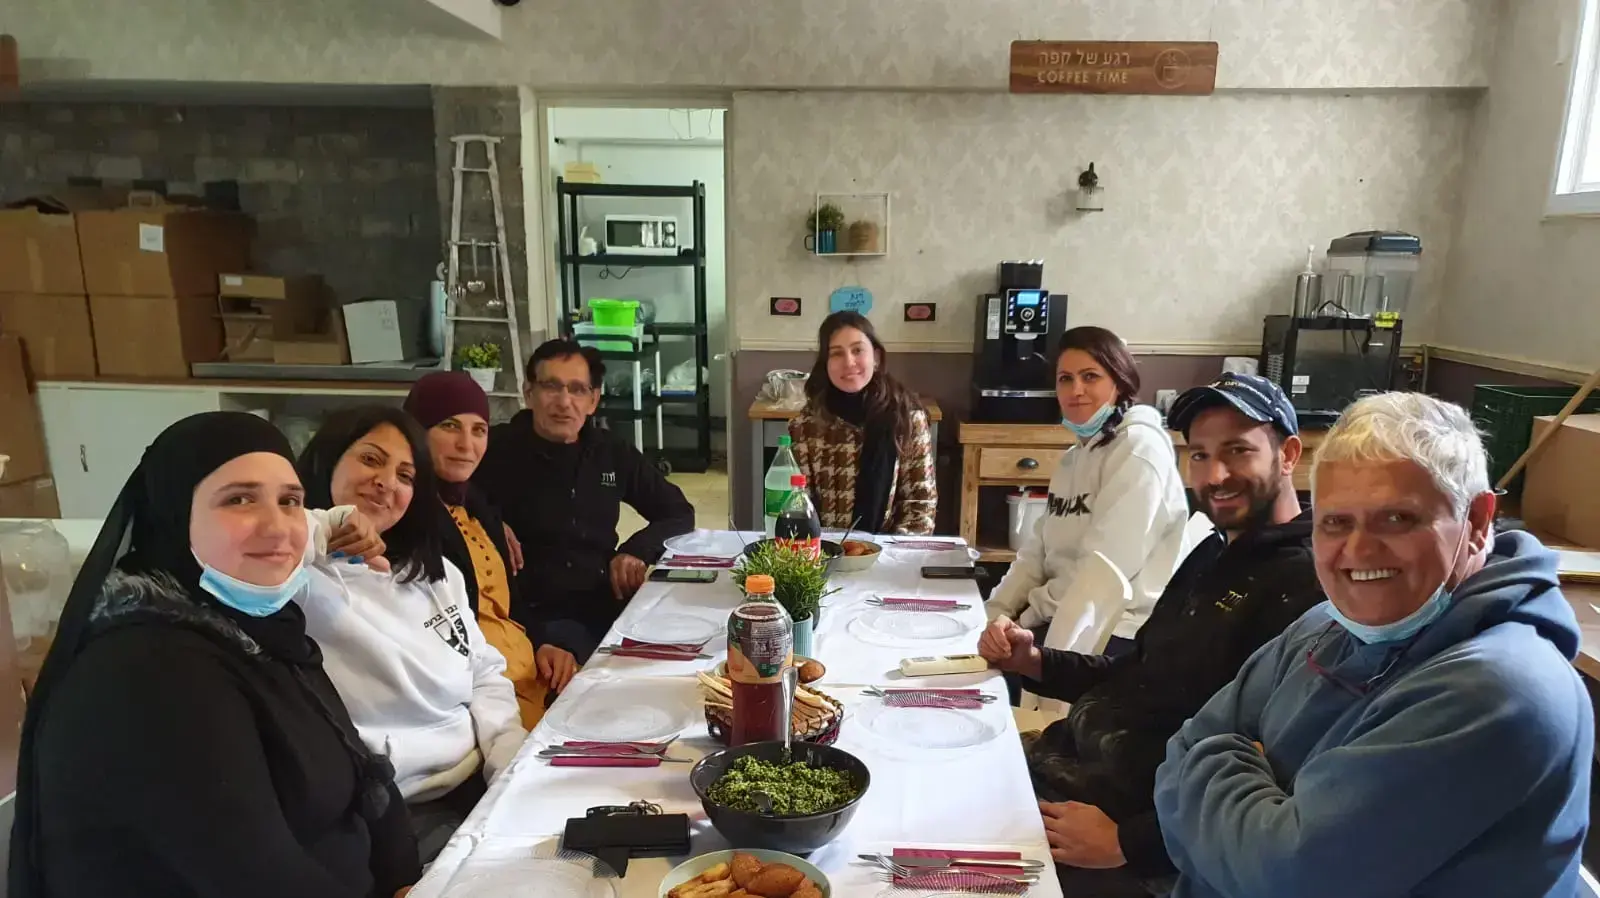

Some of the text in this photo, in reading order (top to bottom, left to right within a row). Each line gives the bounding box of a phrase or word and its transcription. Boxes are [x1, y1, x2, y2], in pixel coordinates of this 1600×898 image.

[1039, 48, 1130, 68] רגע של קפה
[1037, 70, 1128, 83] COFFEE TIME
